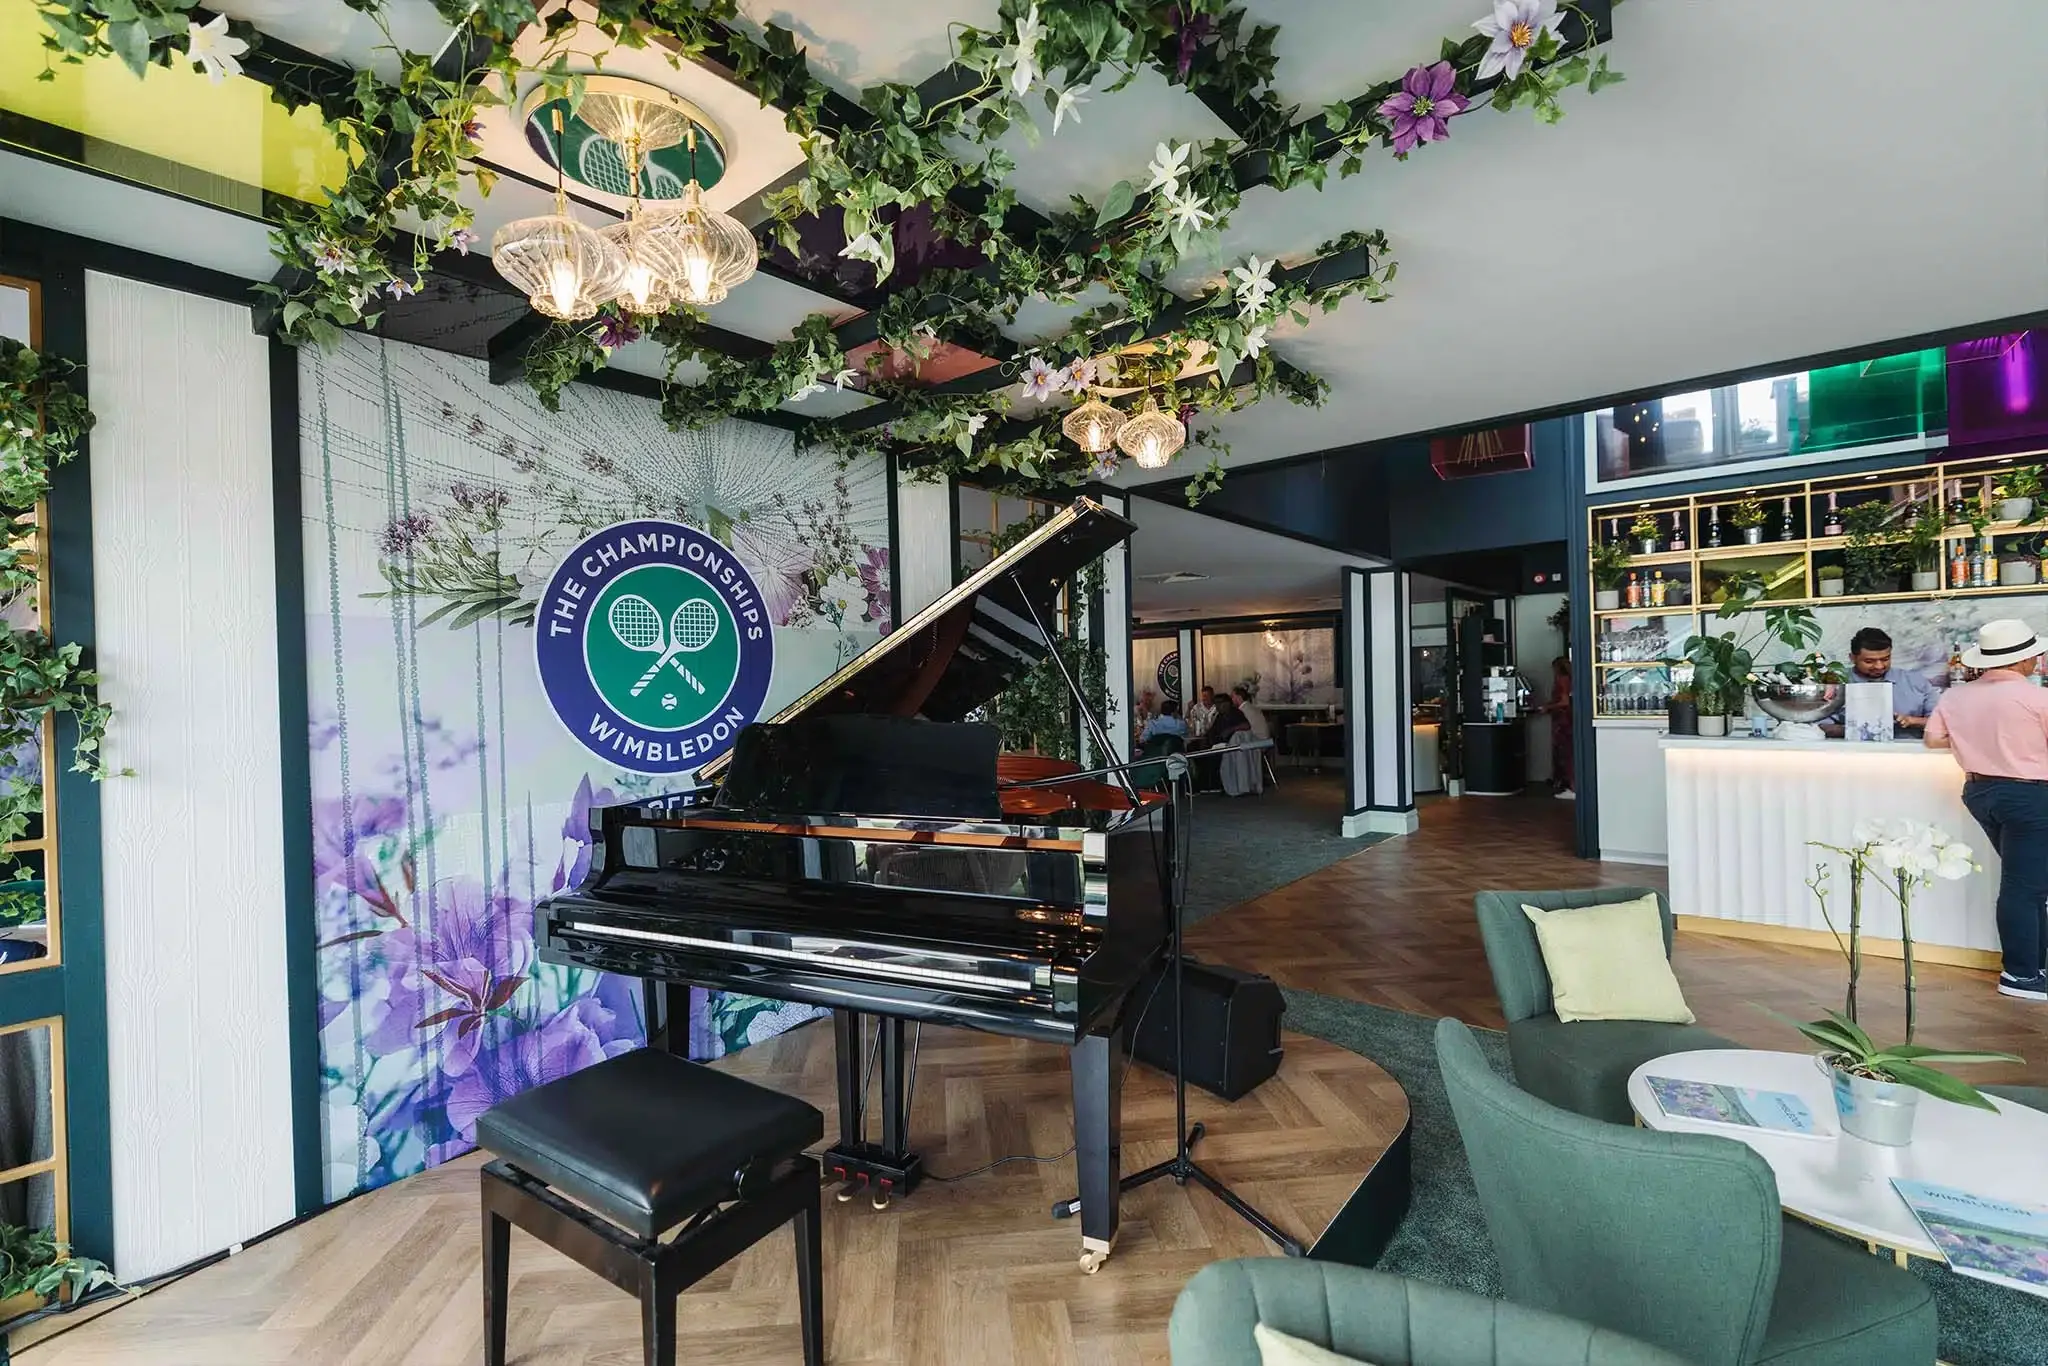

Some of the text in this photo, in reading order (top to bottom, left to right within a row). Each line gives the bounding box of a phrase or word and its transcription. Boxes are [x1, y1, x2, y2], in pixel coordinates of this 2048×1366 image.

[550, 533, 764, 641] THE CHAMPIONSHIPS
[588, 706, 745, 762] WIMBLEDON
